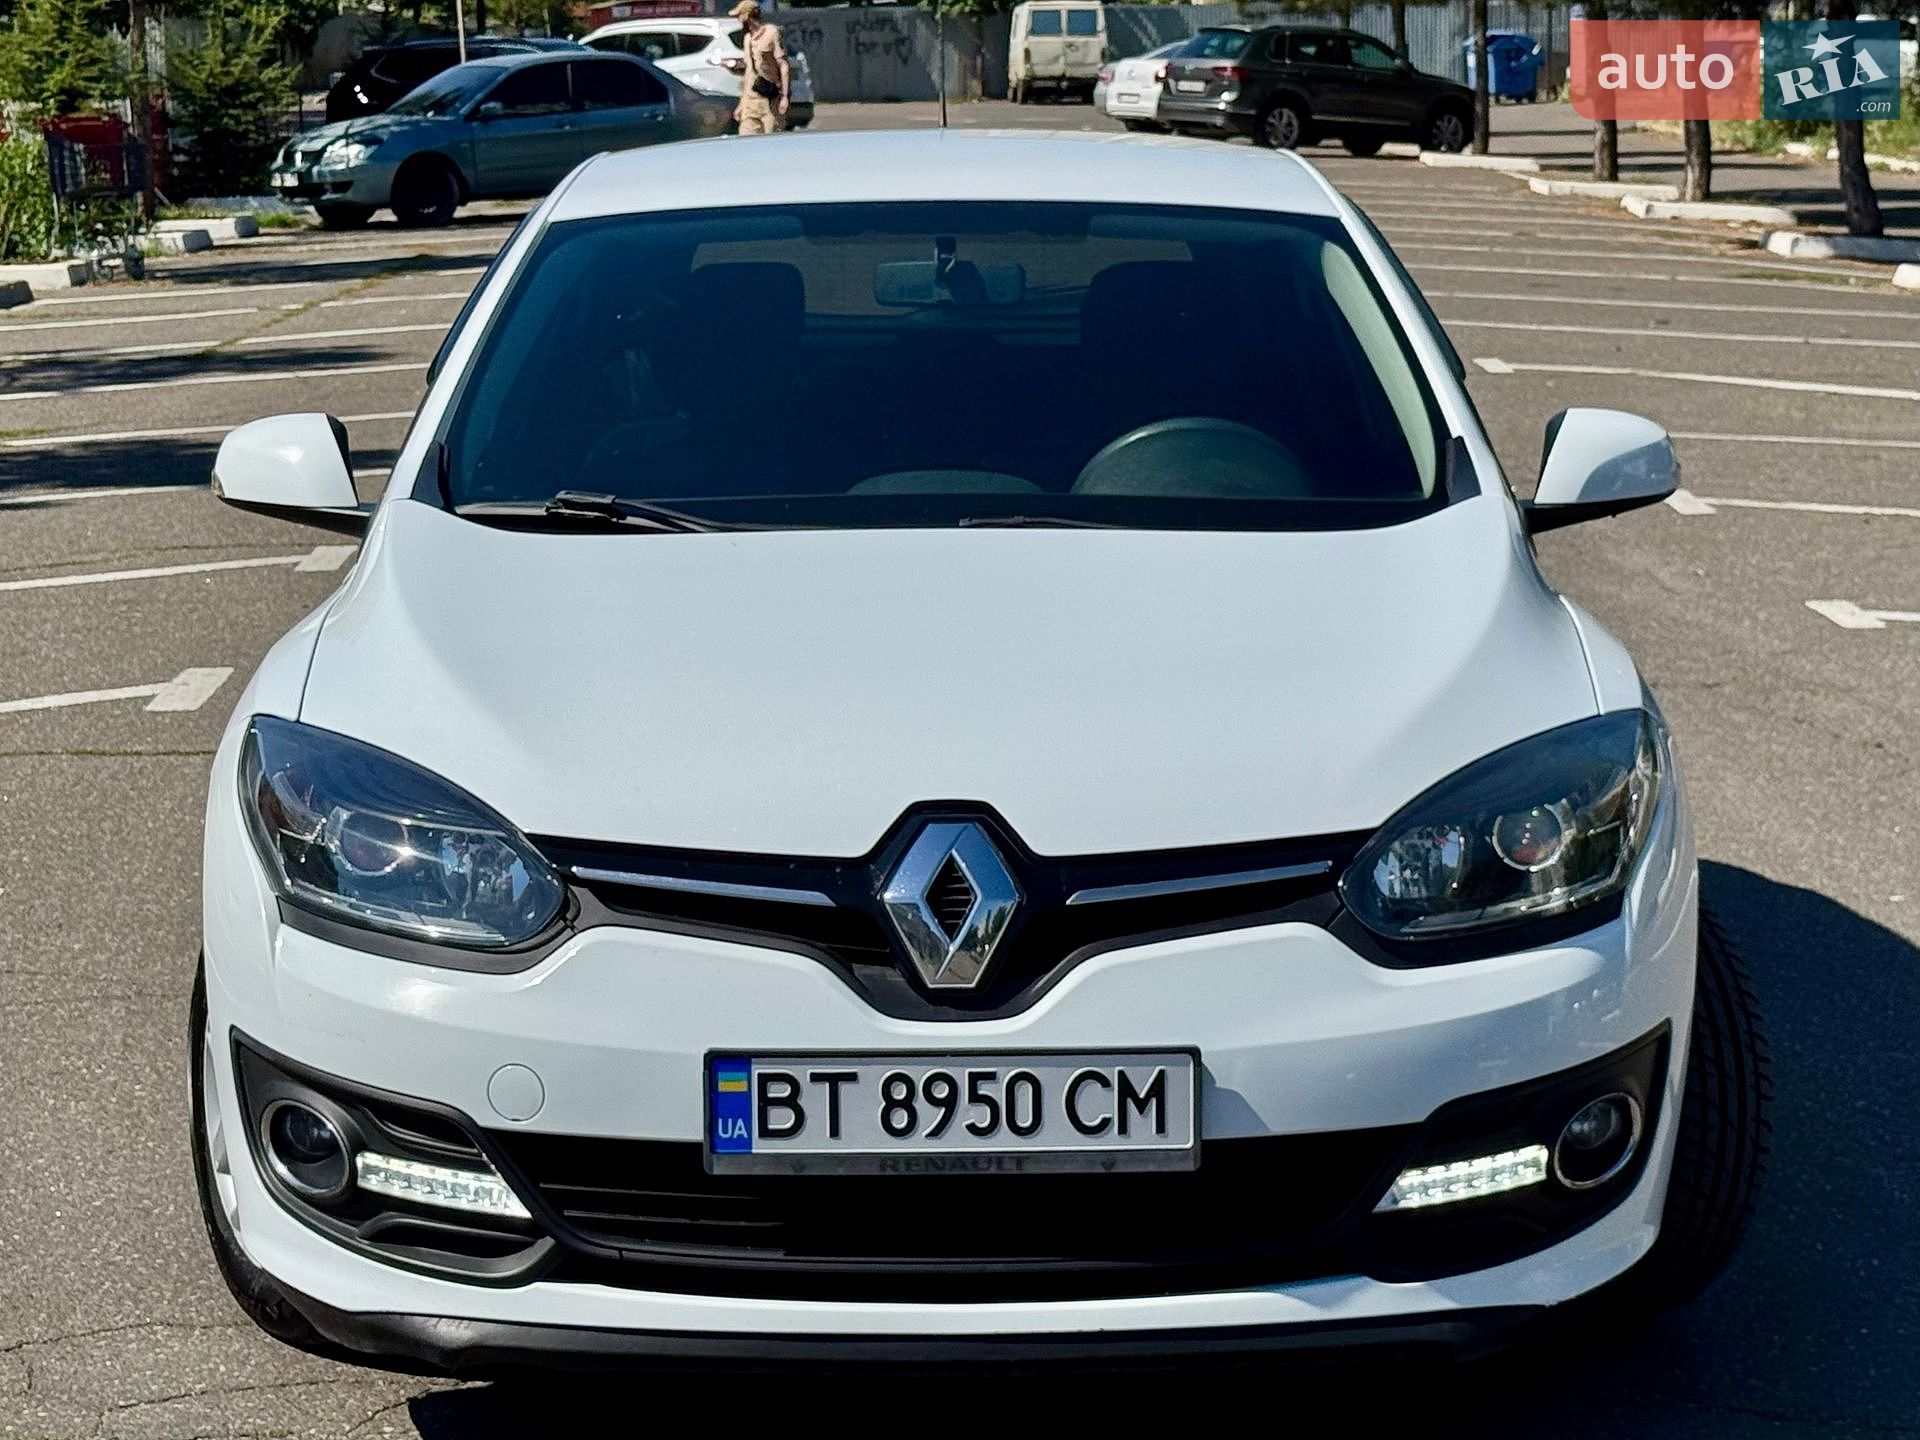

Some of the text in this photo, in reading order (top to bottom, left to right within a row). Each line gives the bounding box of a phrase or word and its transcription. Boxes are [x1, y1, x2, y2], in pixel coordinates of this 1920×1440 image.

[756, 1066, 1166, 1139] BT 8950 CM
[717, 1117, 748, 1140] UA
[879, 1155, 1030, 1172] RENAULT
